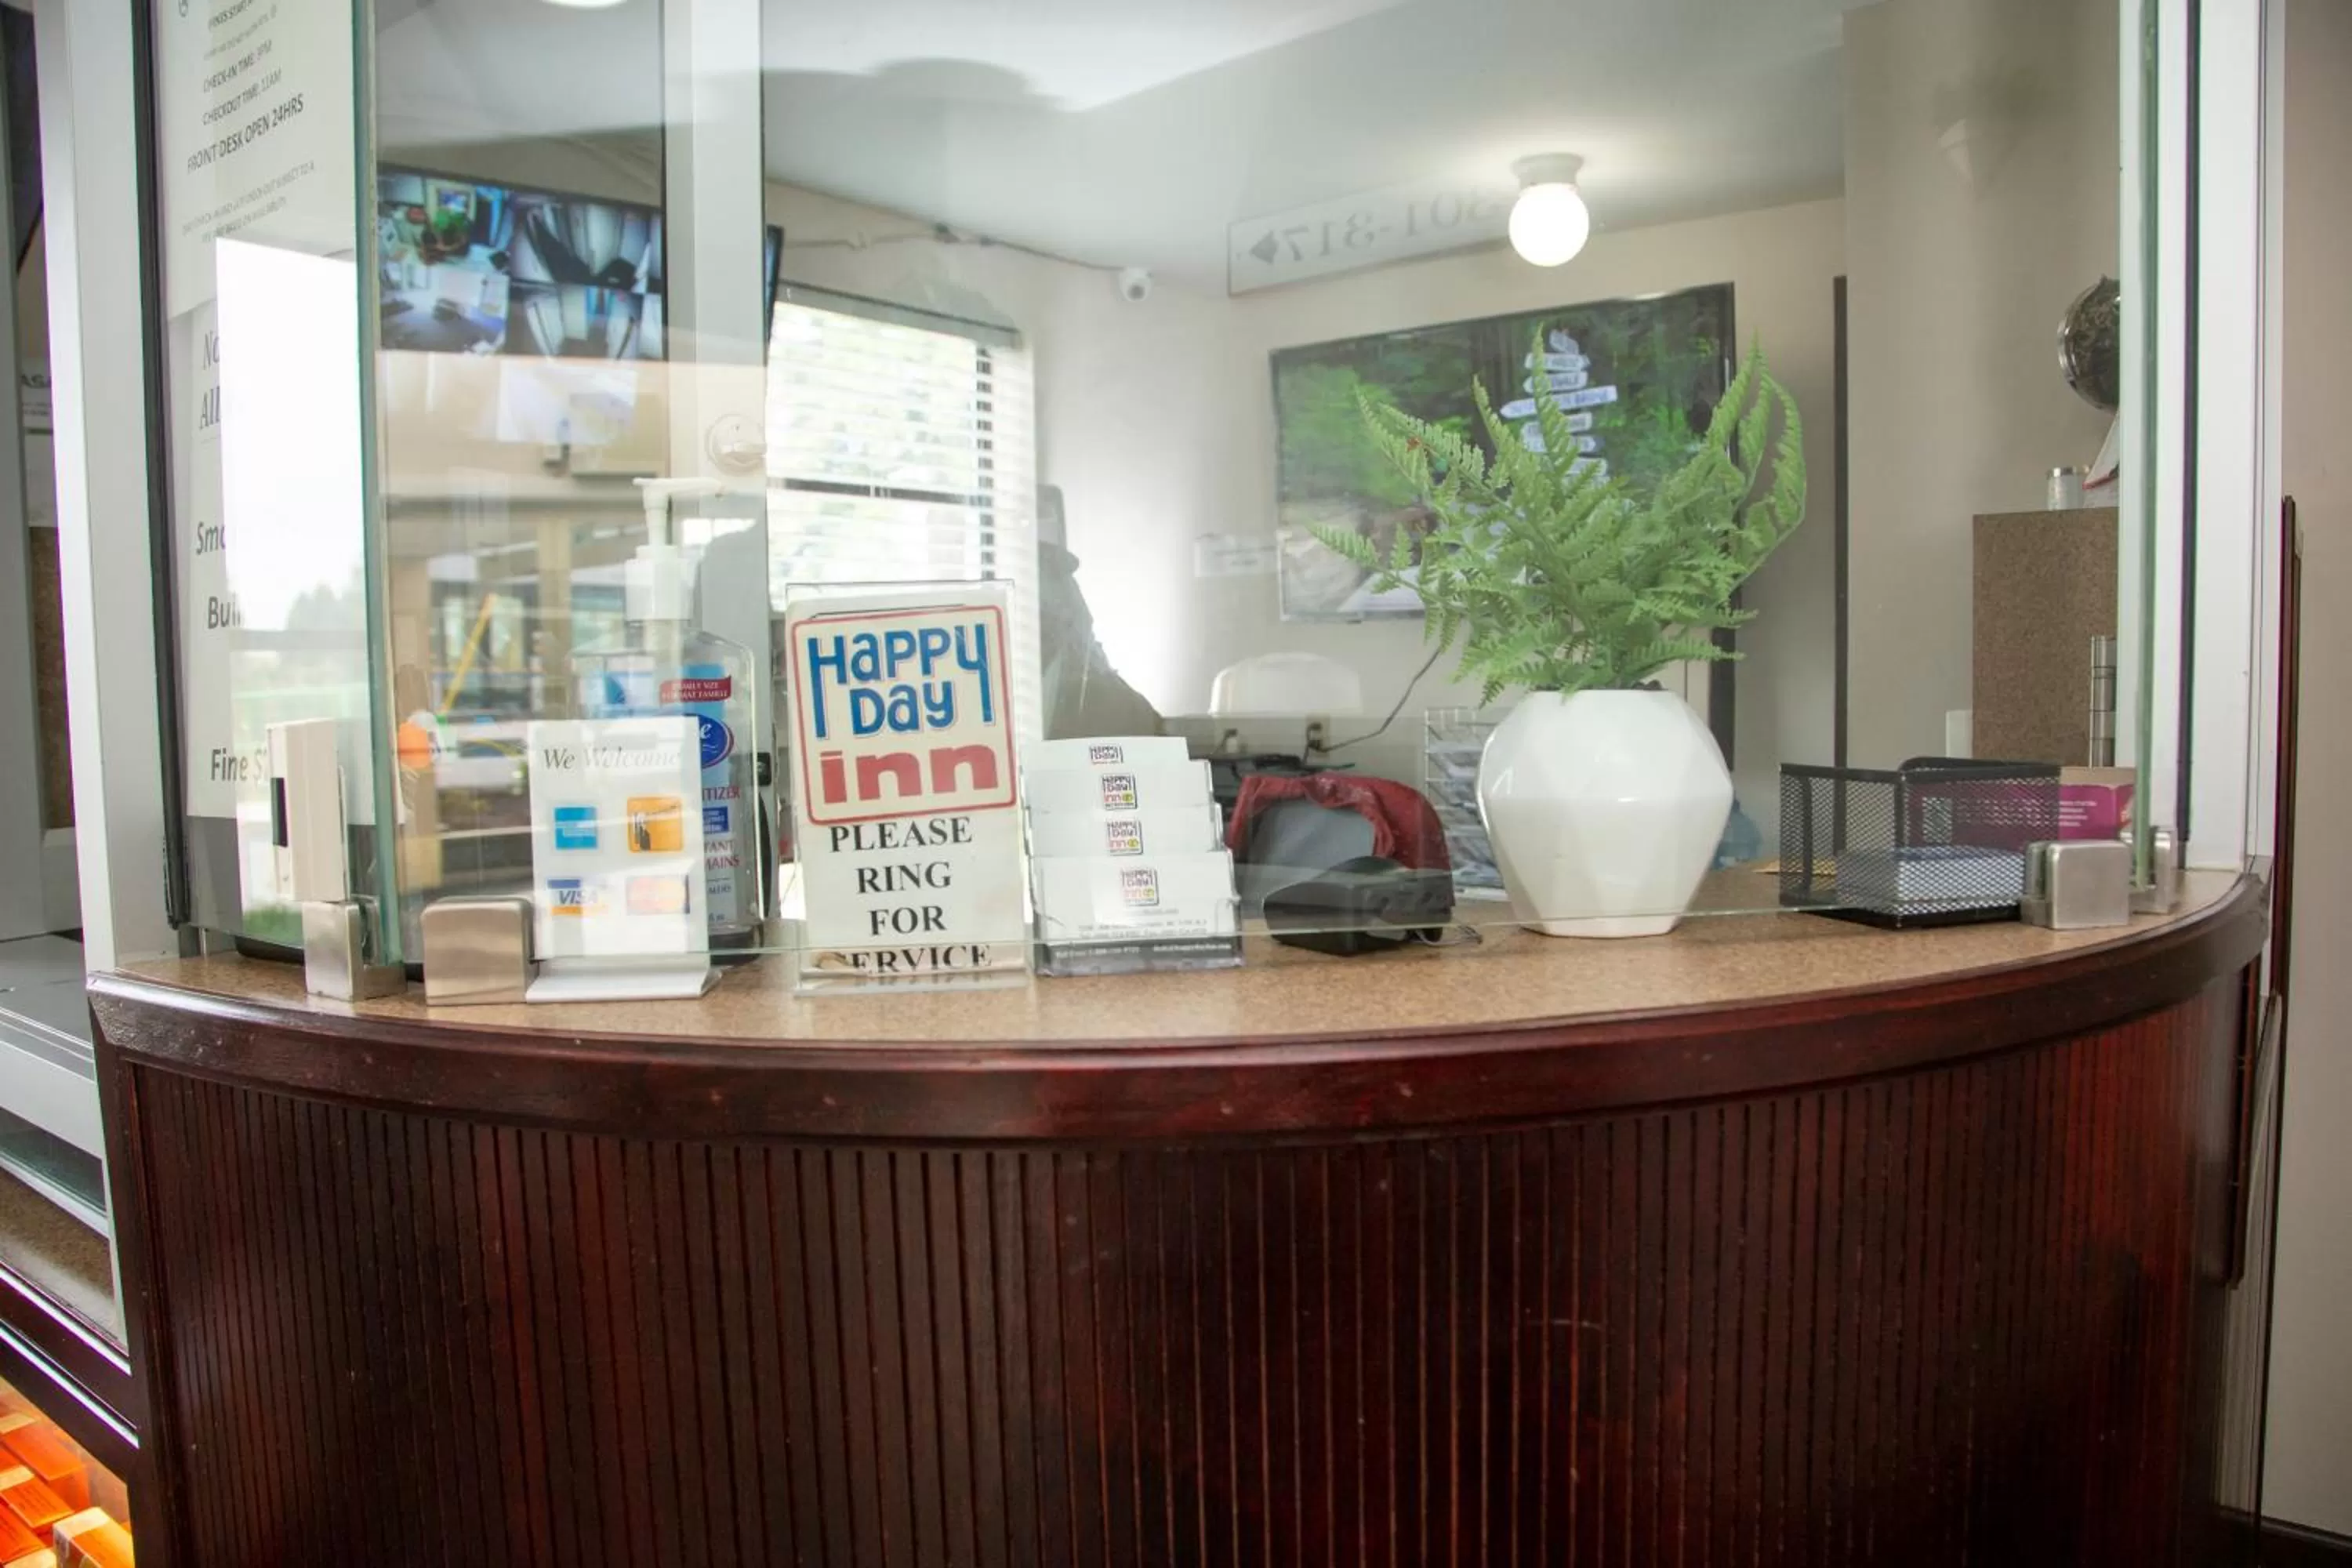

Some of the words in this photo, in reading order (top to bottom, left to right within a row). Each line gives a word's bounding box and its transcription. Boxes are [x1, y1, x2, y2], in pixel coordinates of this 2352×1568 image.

[187, 144, 216, 175] FRONT
[219, 130, 244, 158] DESK
[245, 113, 270, 143] OPEN
[272, 93, 304, 128] 24HRS
[211, 747, 248, 781] Fine
[543, 747, 575, 769] We
[819, 744, 999, 804] inn
[829, 816, 974, 853] PLEASE
[856, 862, 953, 895] RING
[867, 905, 948, 936] FOR
[837, 944, 993, 975] ERVICE
